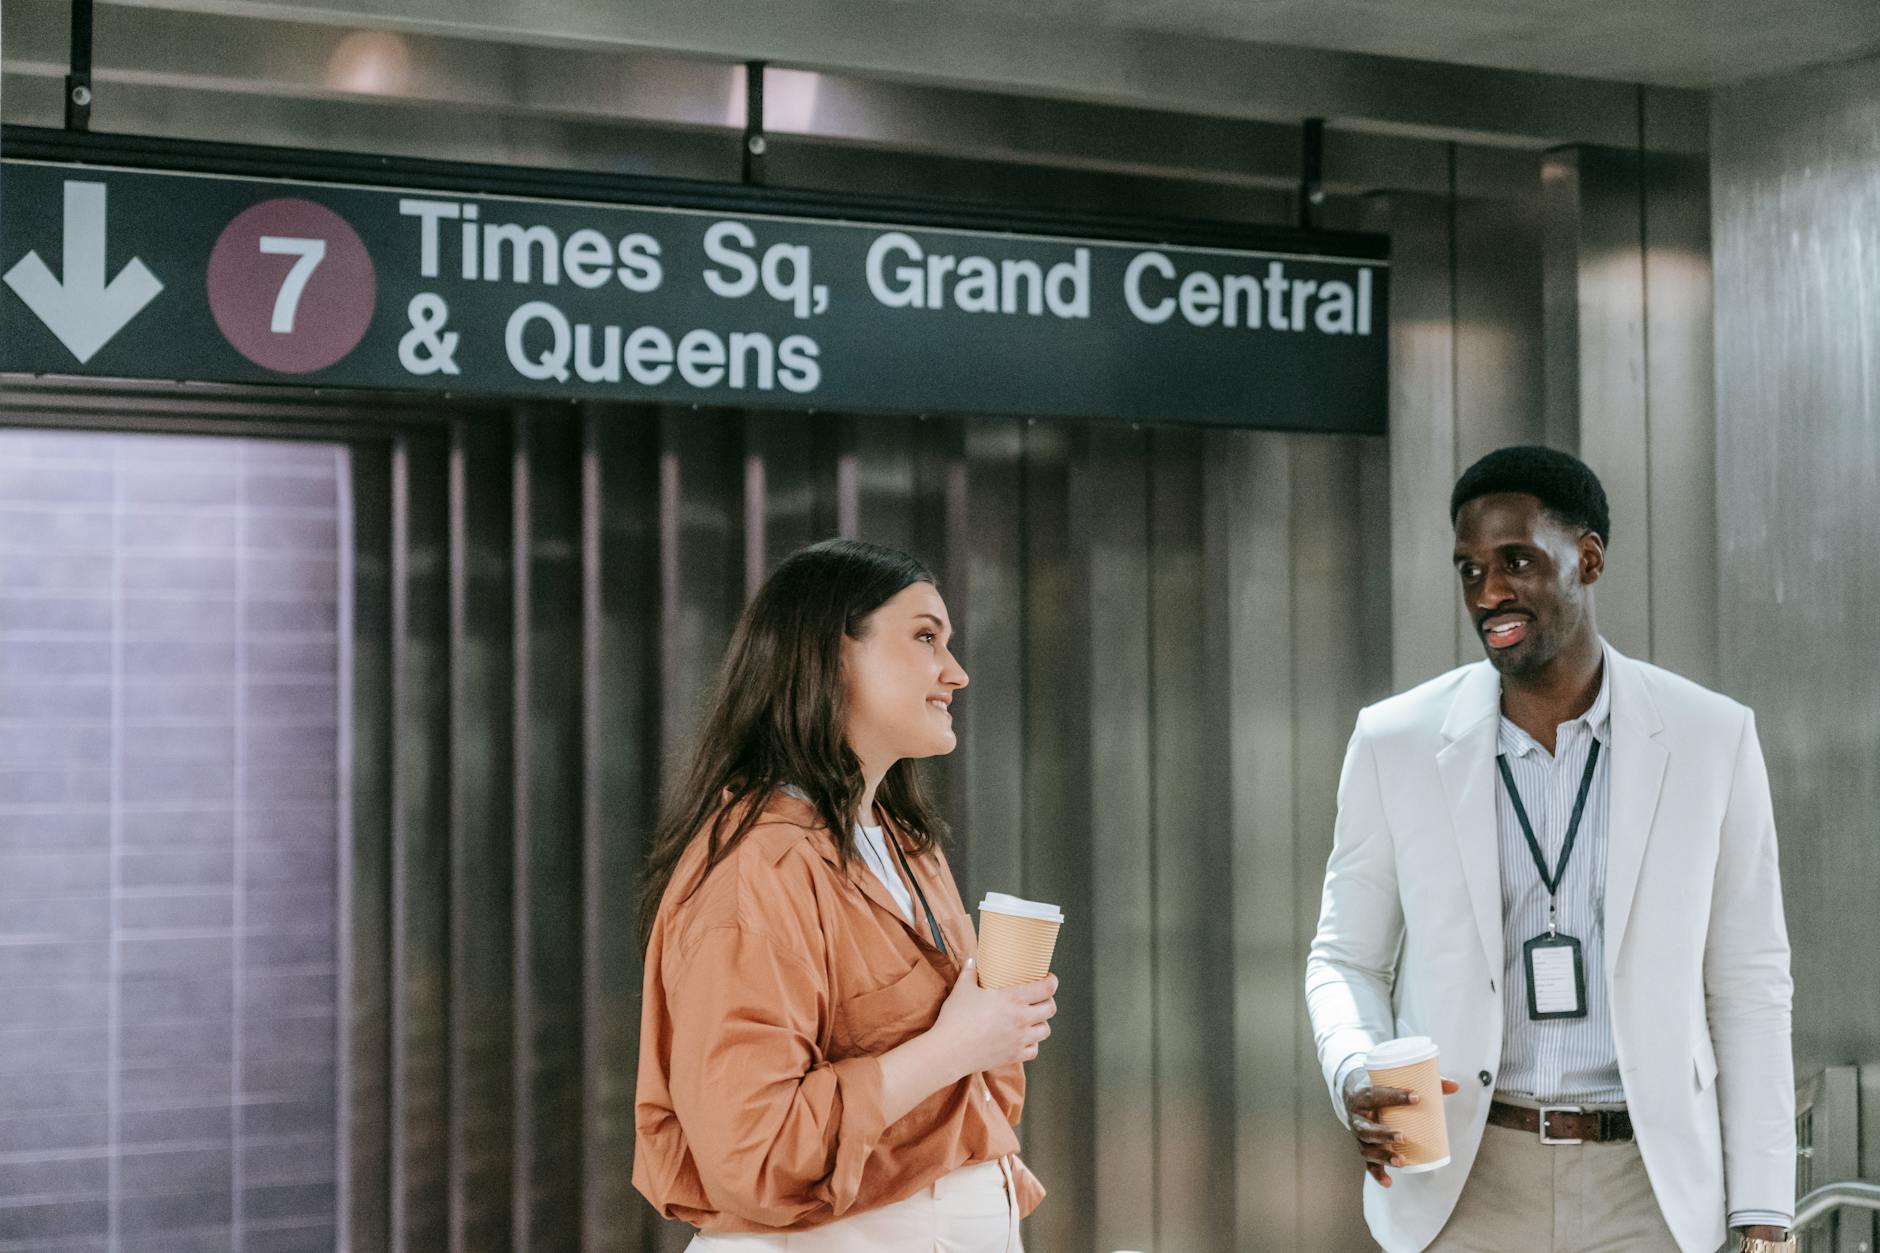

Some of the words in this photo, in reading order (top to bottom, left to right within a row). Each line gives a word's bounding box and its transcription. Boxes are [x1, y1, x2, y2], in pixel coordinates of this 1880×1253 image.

[259, 234, 327, 334] 7
[399, 199, 662, 292] Times
[702, 221, 828, 319] Sq,
[865, 232, 1090, 318] Grand
[1124, 252, 1371, 334] Central
[398, 293, 460, 375] &
[505, 301, 820, 392] Queens
